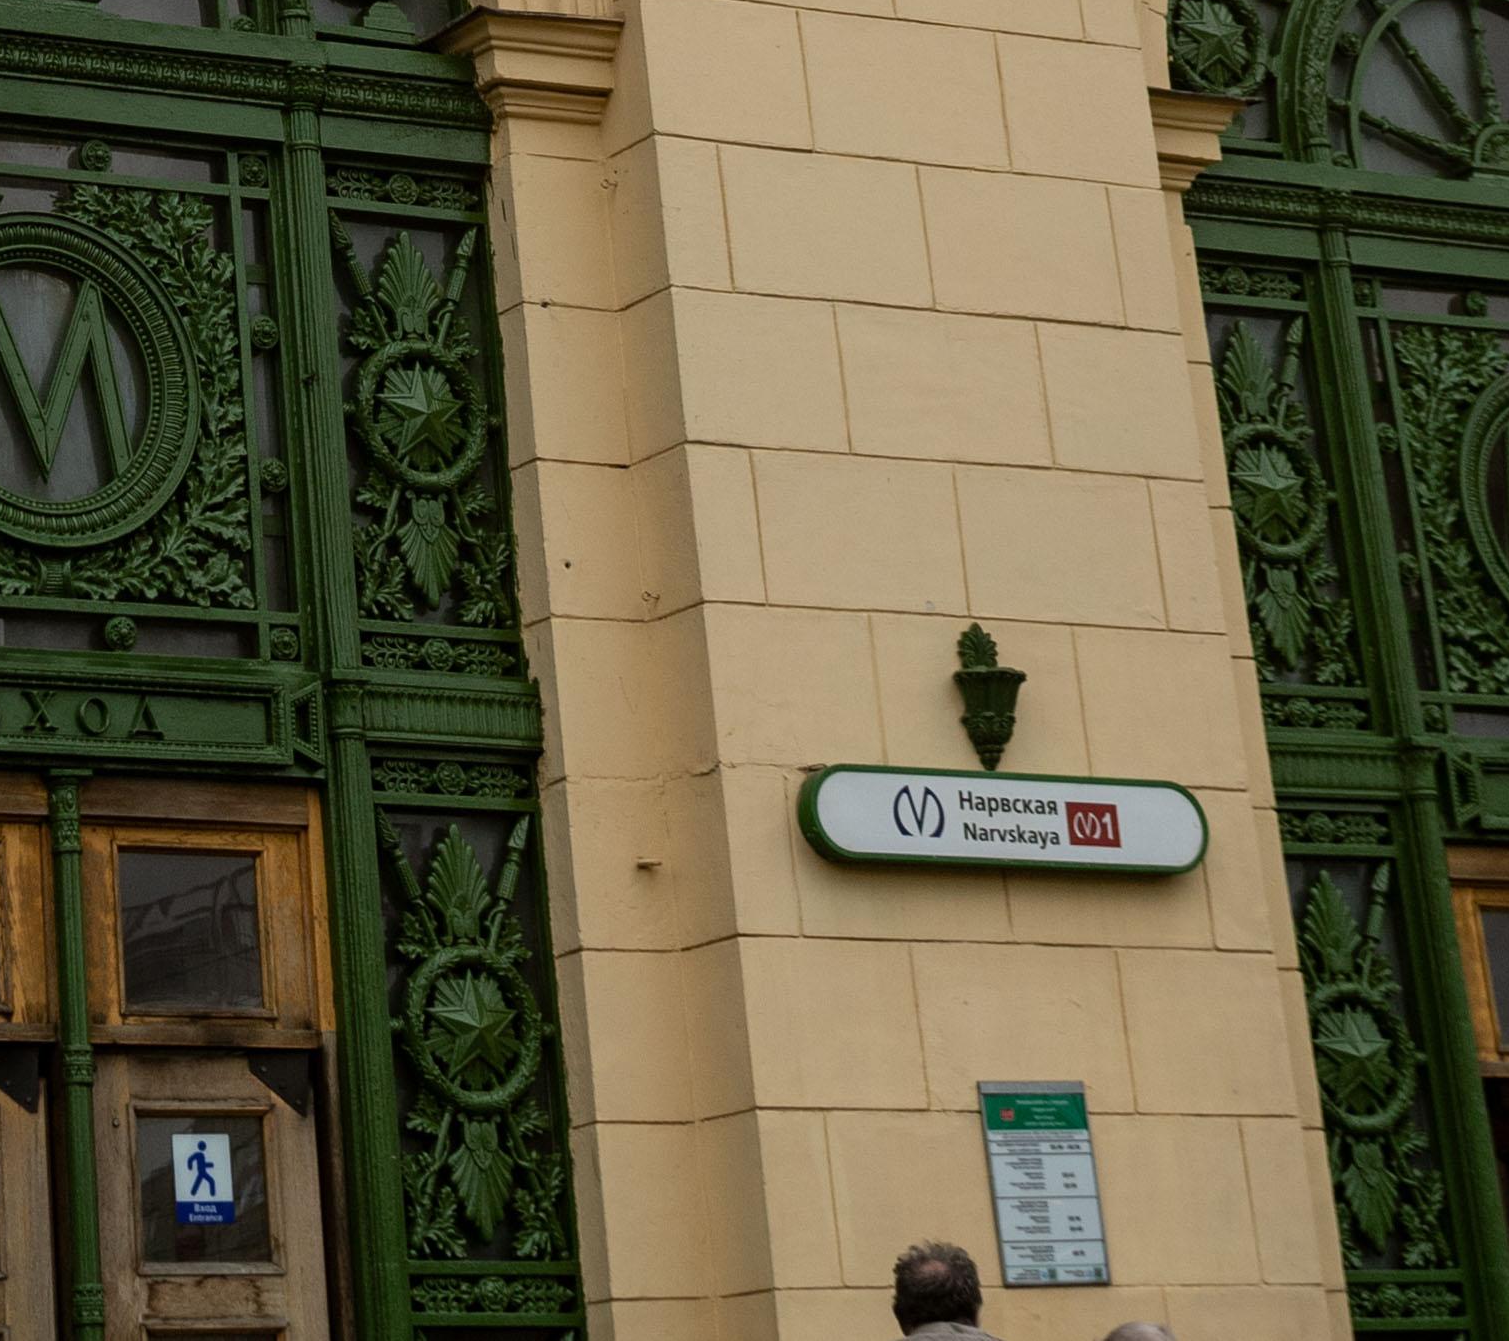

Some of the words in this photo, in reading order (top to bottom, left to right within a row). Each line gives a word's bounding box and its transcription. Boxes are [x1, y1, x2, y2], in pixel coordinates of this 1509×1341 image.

[958, 790, 1059, 818] Нарвская
[963, 822, 1061, 850] Narvskaya
[189, 1213, 223, 1222] Entrance
